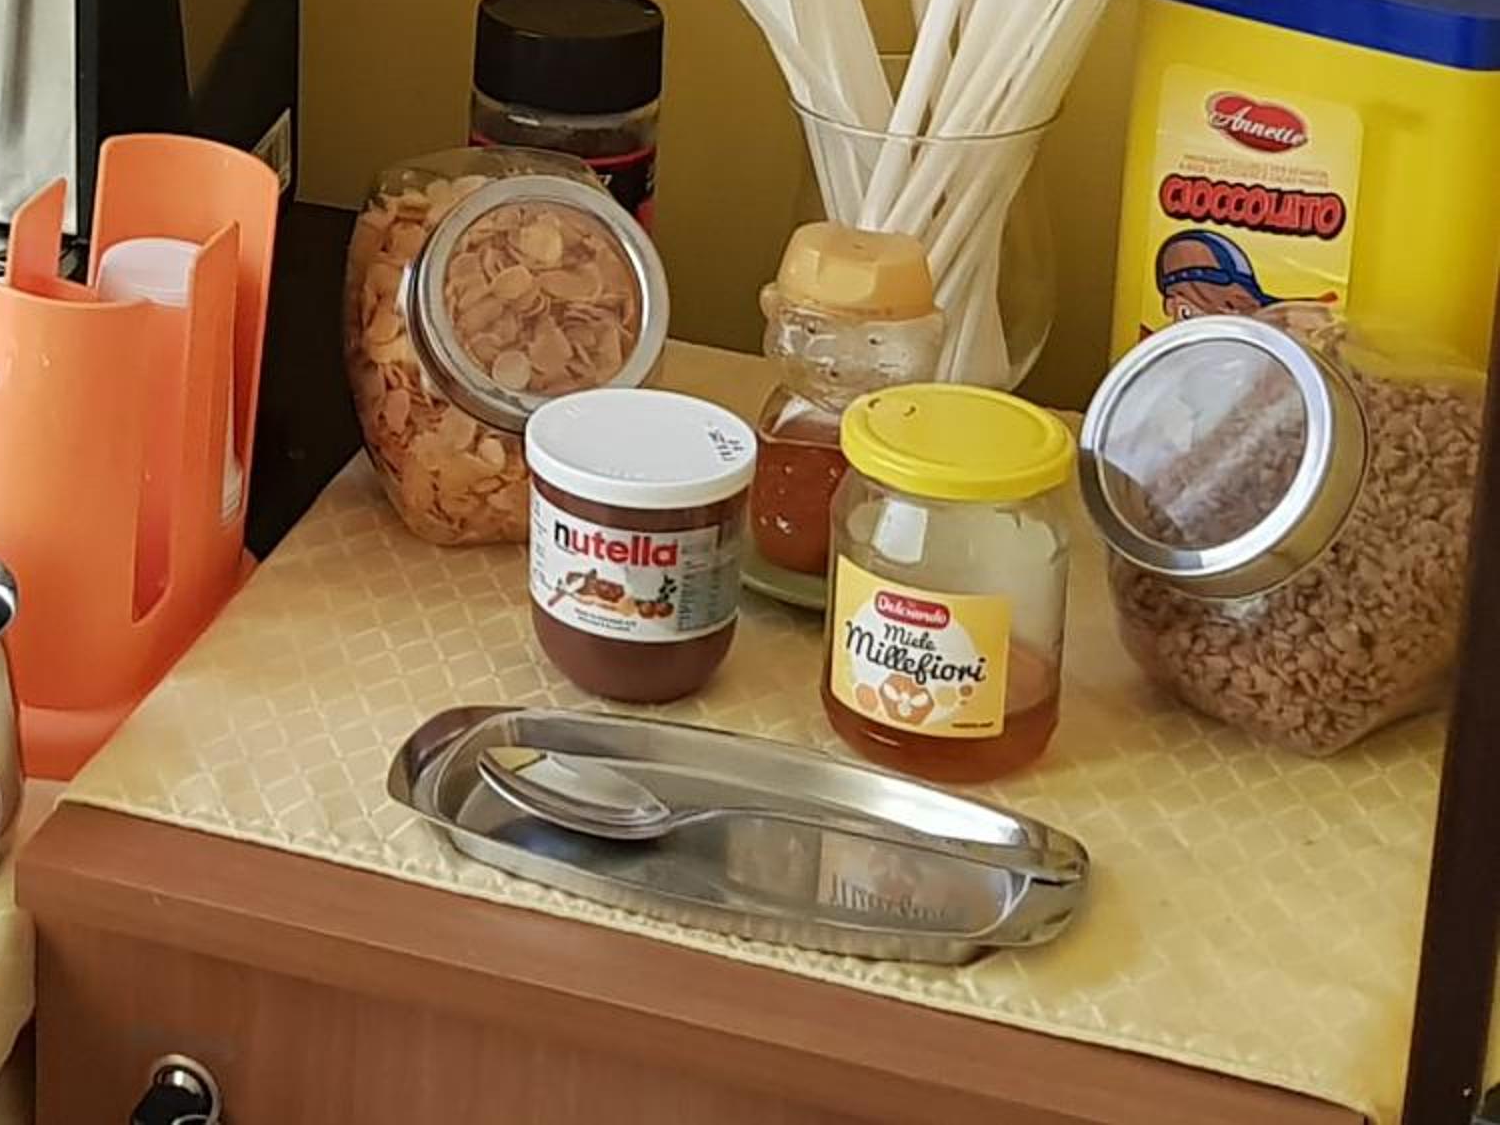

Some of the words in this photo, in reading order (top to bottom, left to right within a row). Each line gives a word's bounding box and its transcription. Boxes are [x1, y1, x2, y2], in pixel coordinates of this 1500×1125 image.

[1160, 174, 1345, 239] CIOCCOLATO
[554, 519, 679, 568] nutella
[845, 619, 987, 686] Millefiori
[884, 623, 937, 651] Miele
